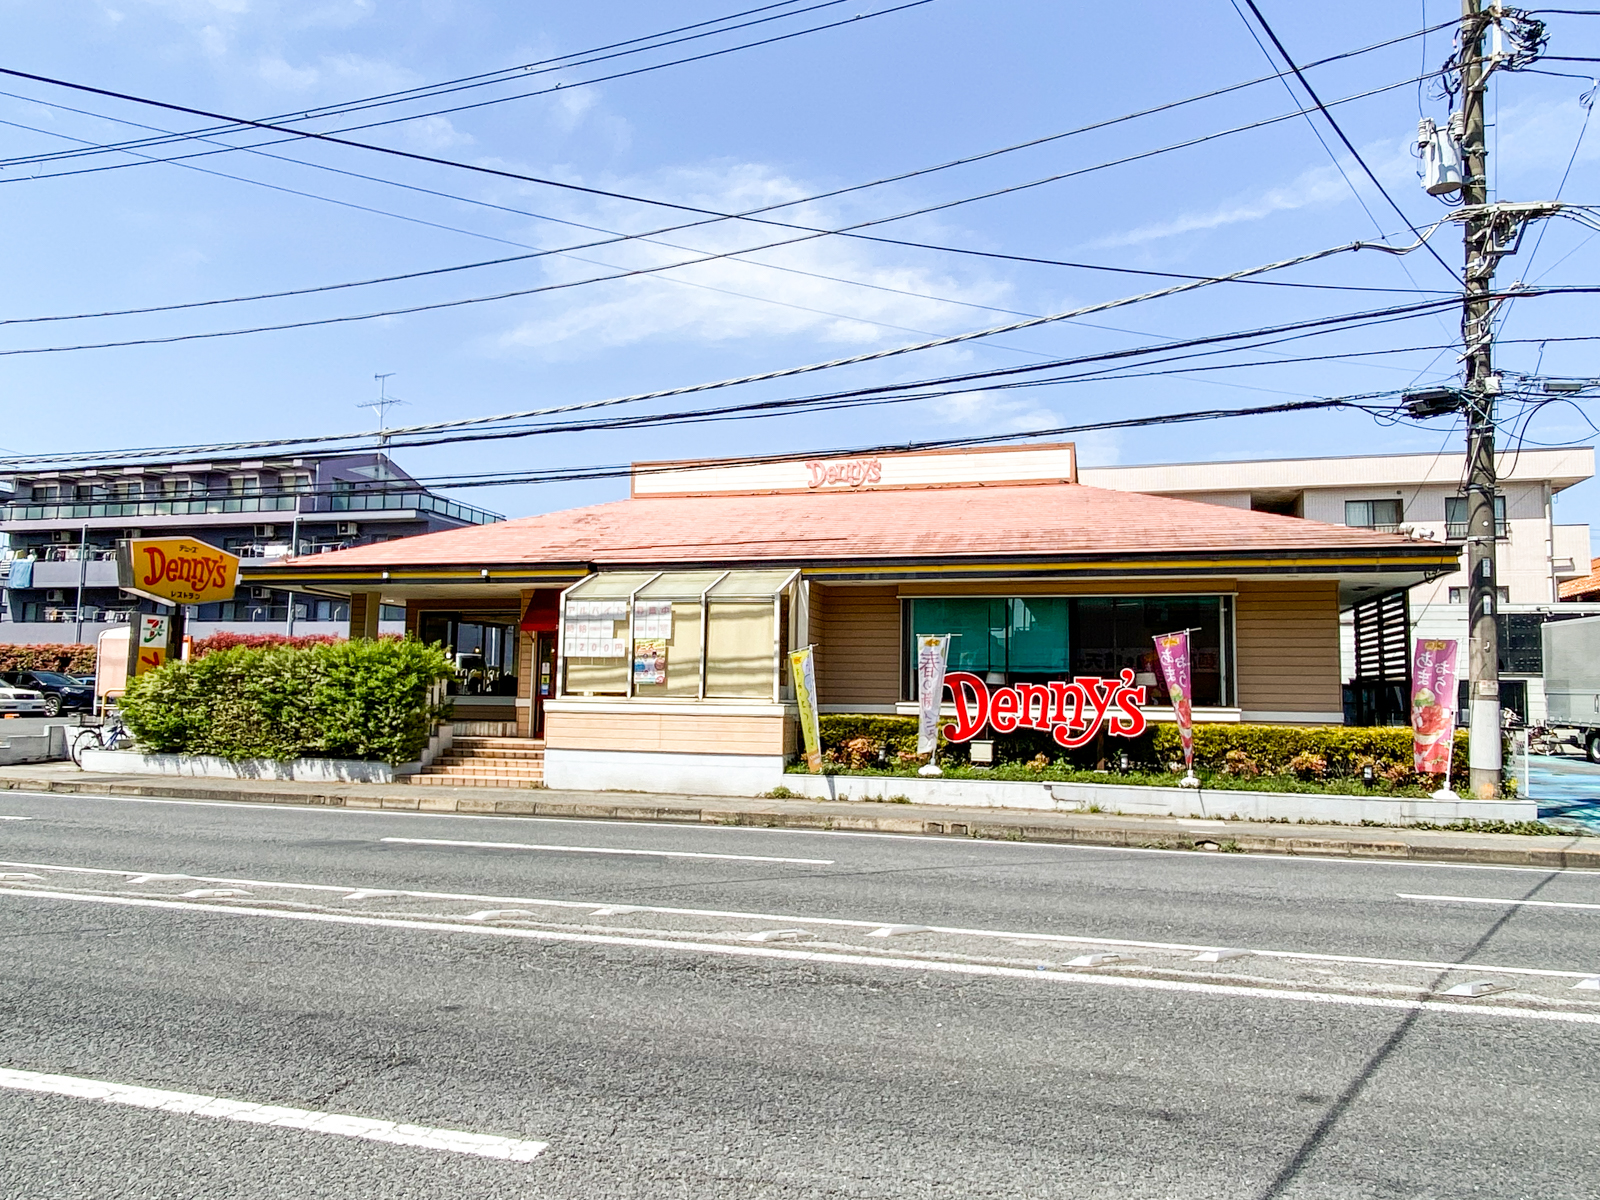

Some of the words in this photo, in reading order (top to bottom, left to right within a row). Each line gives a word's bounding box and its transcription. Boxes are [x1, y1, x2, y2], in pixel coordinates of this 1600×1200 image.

[805, 456, 881, 488] Denny's
[143, 547, 226, 592] Denny's
[170, 591, 200, 600] レストラン
[567, 606, 623, 615] アルバイト
[567, 643, 623, 653] 1200円
[943, 668, 1147, 749] Denny's
